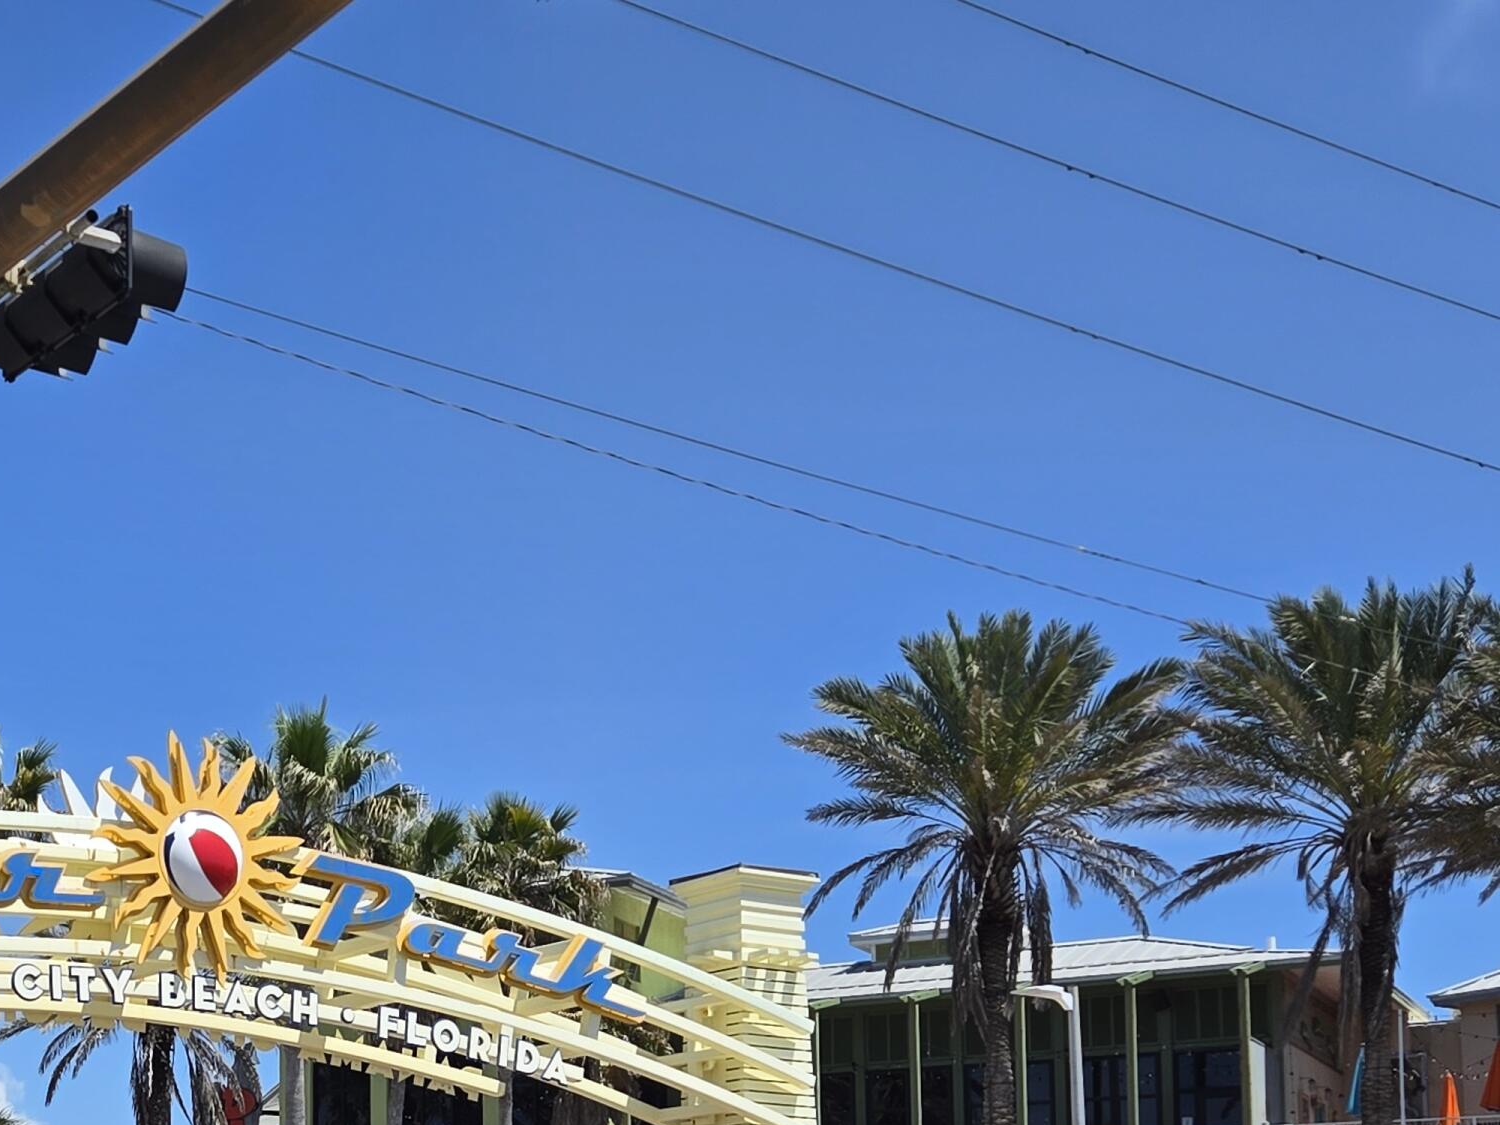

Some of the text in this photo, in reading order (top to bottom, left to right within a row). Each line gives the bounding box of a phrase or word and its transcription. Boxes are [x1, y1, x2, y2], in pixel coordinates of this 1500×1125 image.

[291, 852, 646, 1024] Park
[12, 963, 134, 1004] CITY
[159, 971, 319, 1026] BEACH
[377, 1005, 568, 1086] FLORIDA
